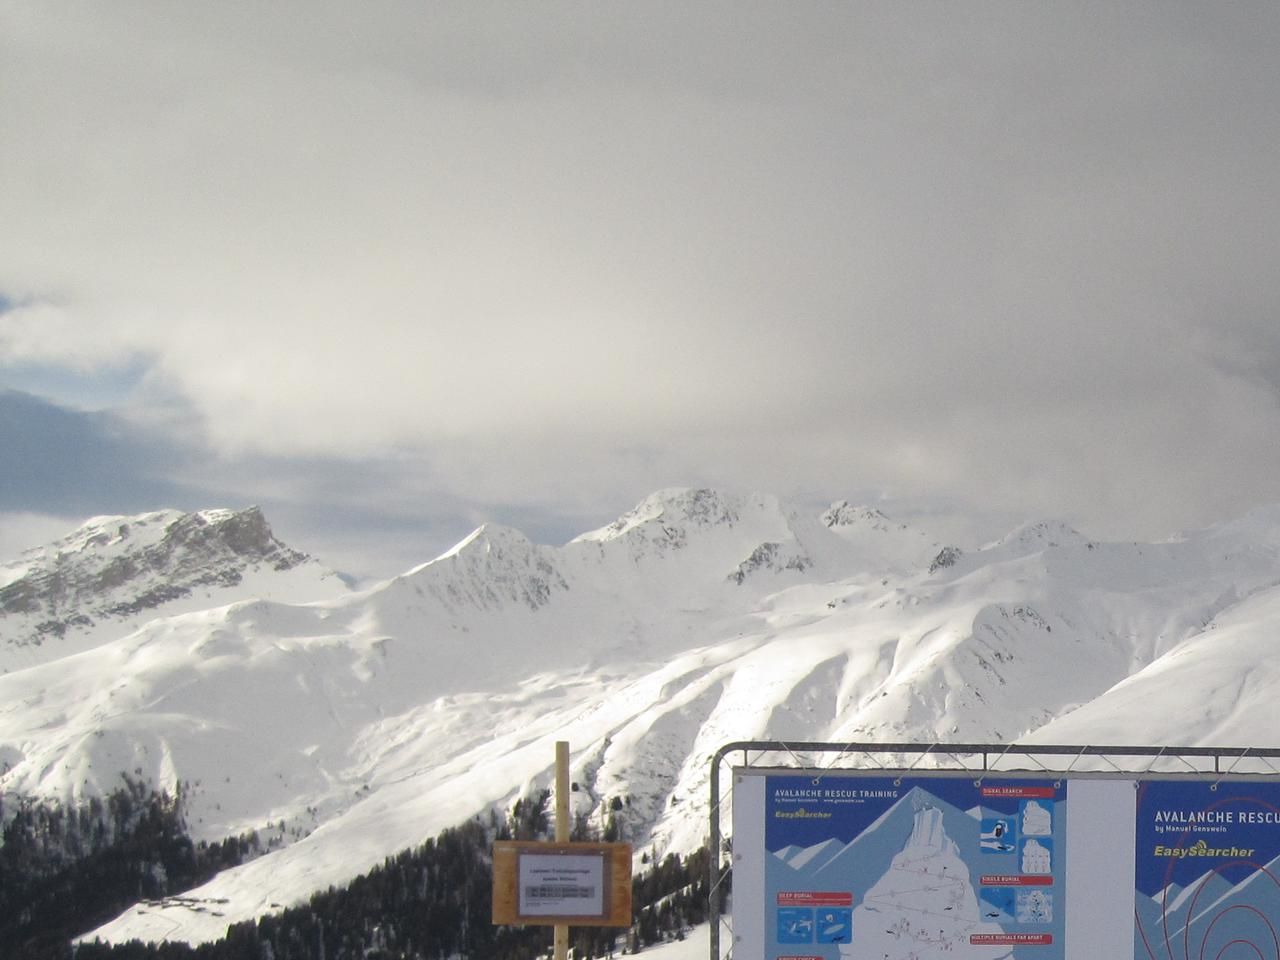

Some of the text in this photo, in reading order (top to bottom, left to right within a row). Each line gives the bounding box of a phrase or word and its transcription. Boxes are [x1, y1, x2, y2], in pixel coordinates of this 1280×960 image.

[775, 790, 822, 798] AVALANCHE
[825, 790, 857, 798] RESCUE
[775, 811, 832, 819] EasySearcher
[1155, 811, 1233, 823] AVALANCHE
[1155, 825, 1164, 833] by
[1154, 844, 1255, 859] EasySearcher
